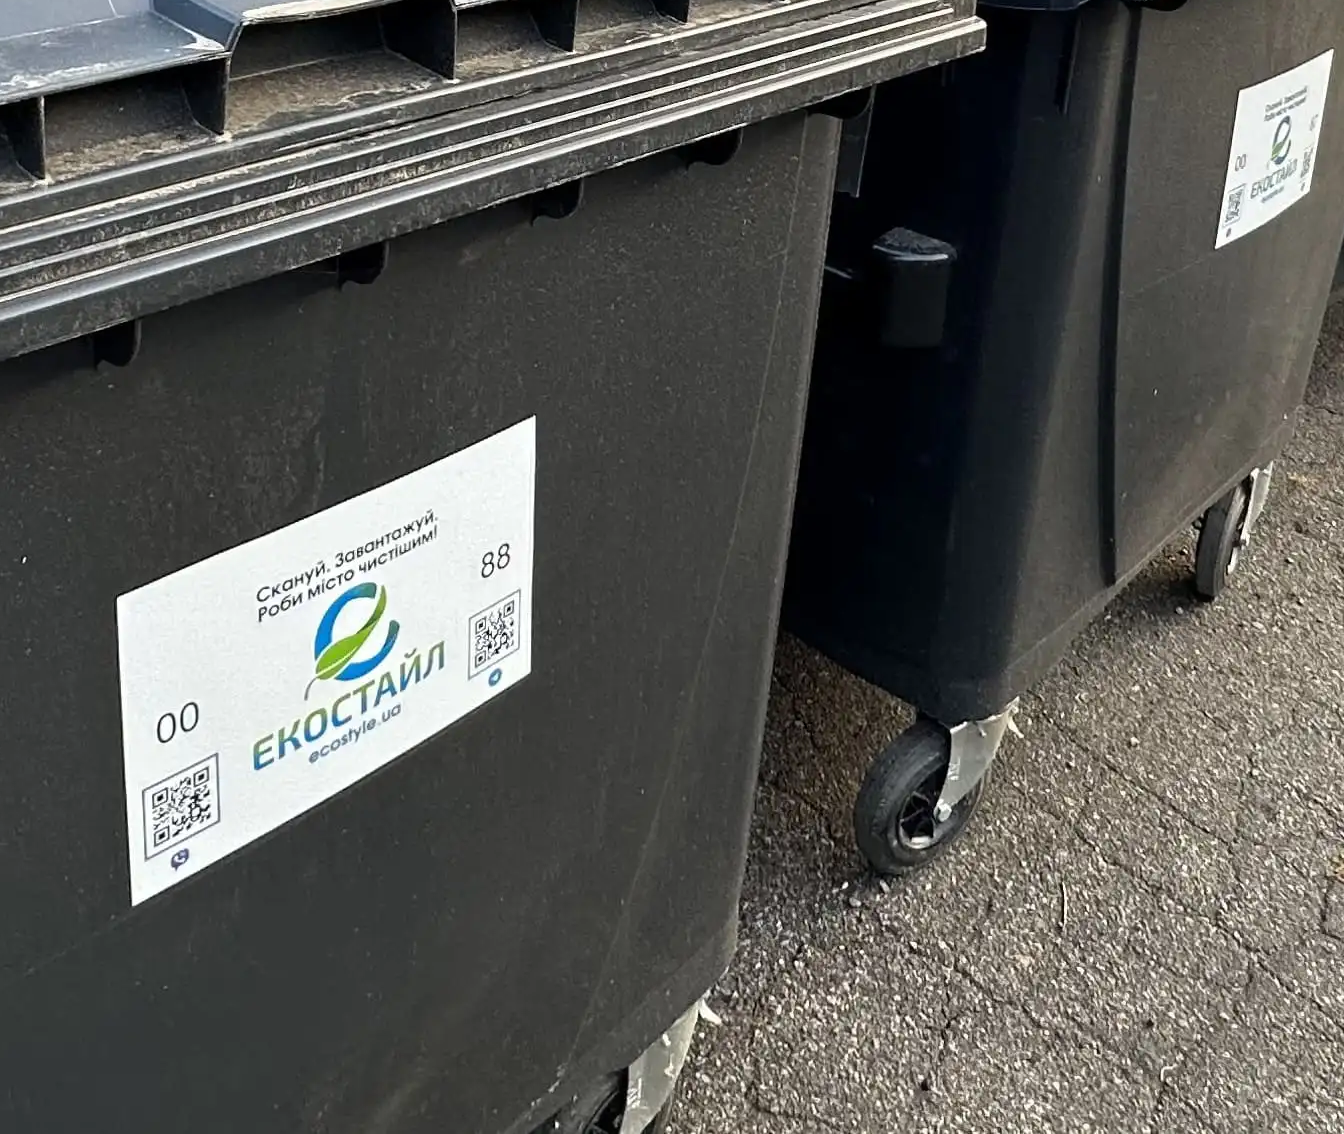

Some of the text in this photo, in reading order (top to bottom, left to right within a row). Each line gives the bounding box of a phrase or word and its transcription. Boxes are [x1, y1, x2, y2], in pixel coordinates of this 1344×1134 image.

[256, 509, 438, 603] Скануй. Завантажуй.
[258, 525, 438, 622] Роби місто чистішим!
[481, 543, 510, 578] 88
[157, 702, 199, 743] 00
[253, 640, 445, 771] ЕКОСТАЙЛ
[308, 704, 402, 764] ecostyle.ua
